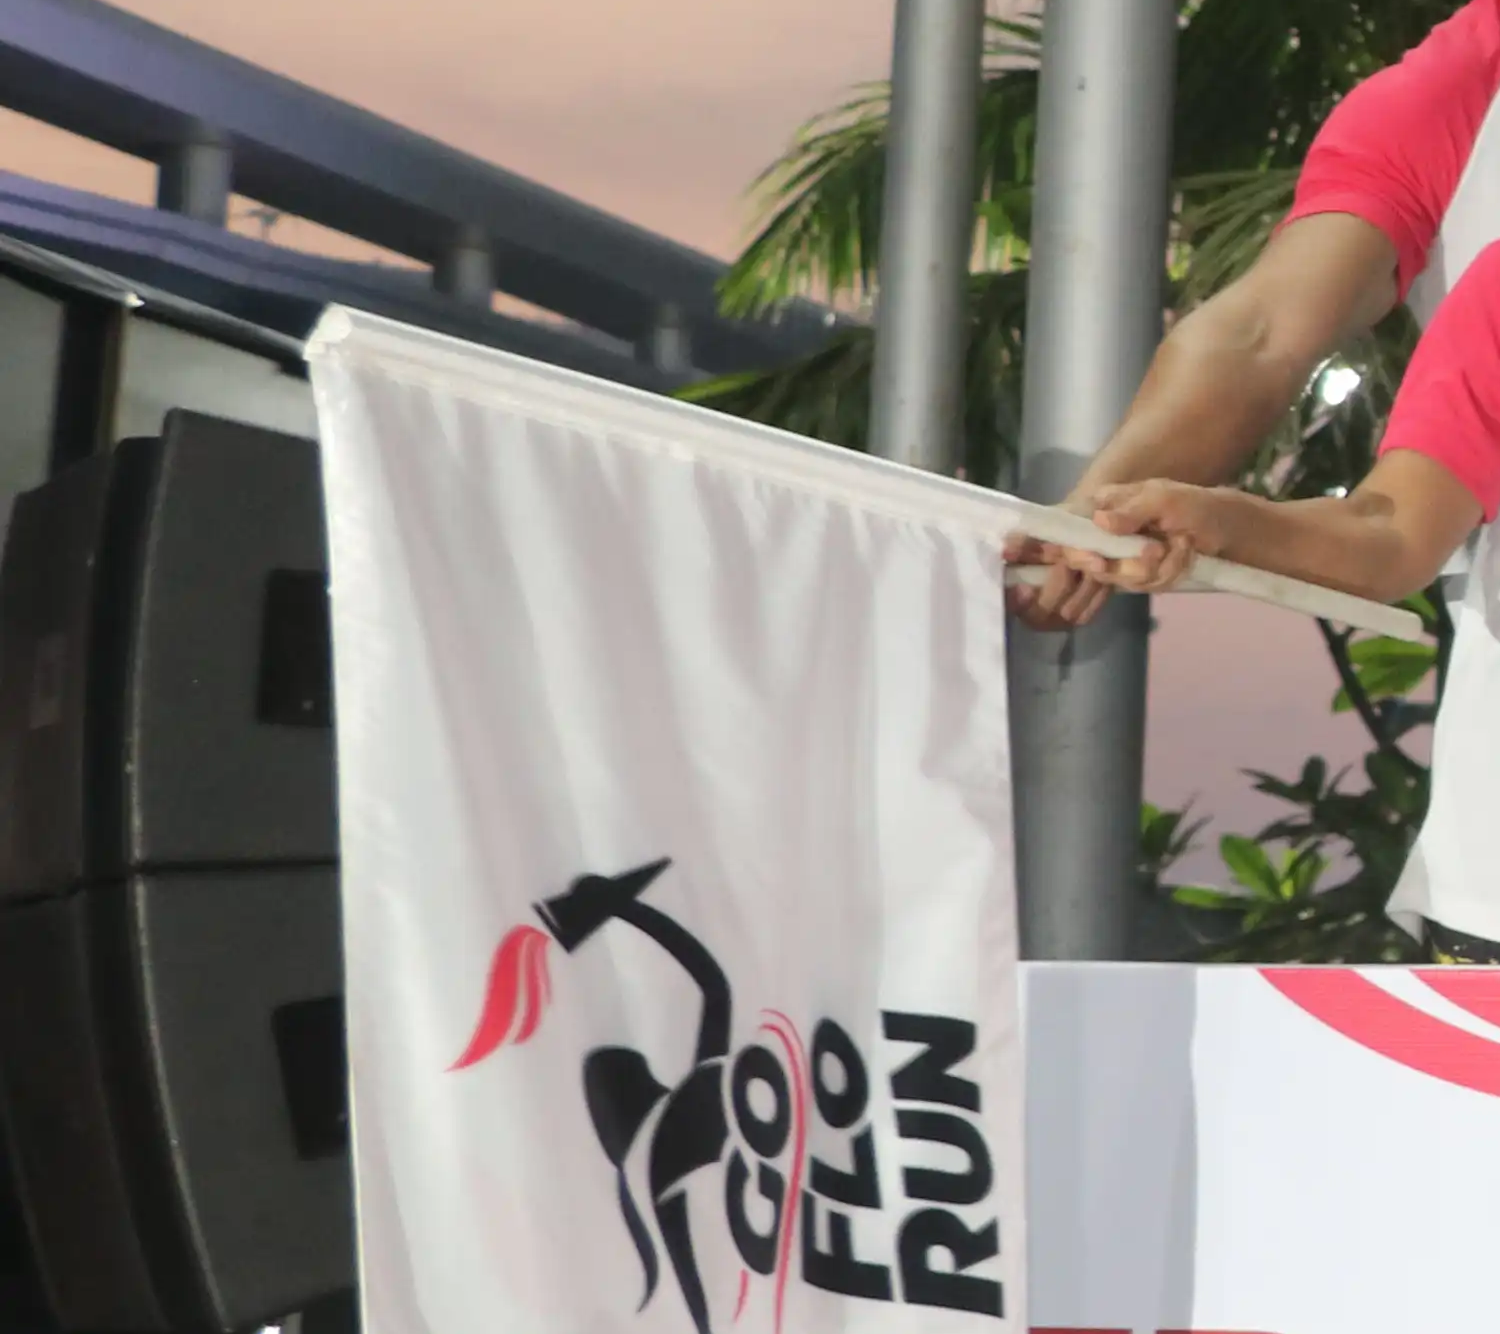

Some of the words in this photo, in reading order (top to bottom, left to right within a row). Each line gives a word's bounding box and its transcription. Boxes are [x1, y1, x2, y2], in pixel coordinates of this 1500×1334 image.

[725, 1044, 791, 1276] GO
[800, 1017, 895, 1302] FLO
[881, 1009, 1005, 1319] RUN
